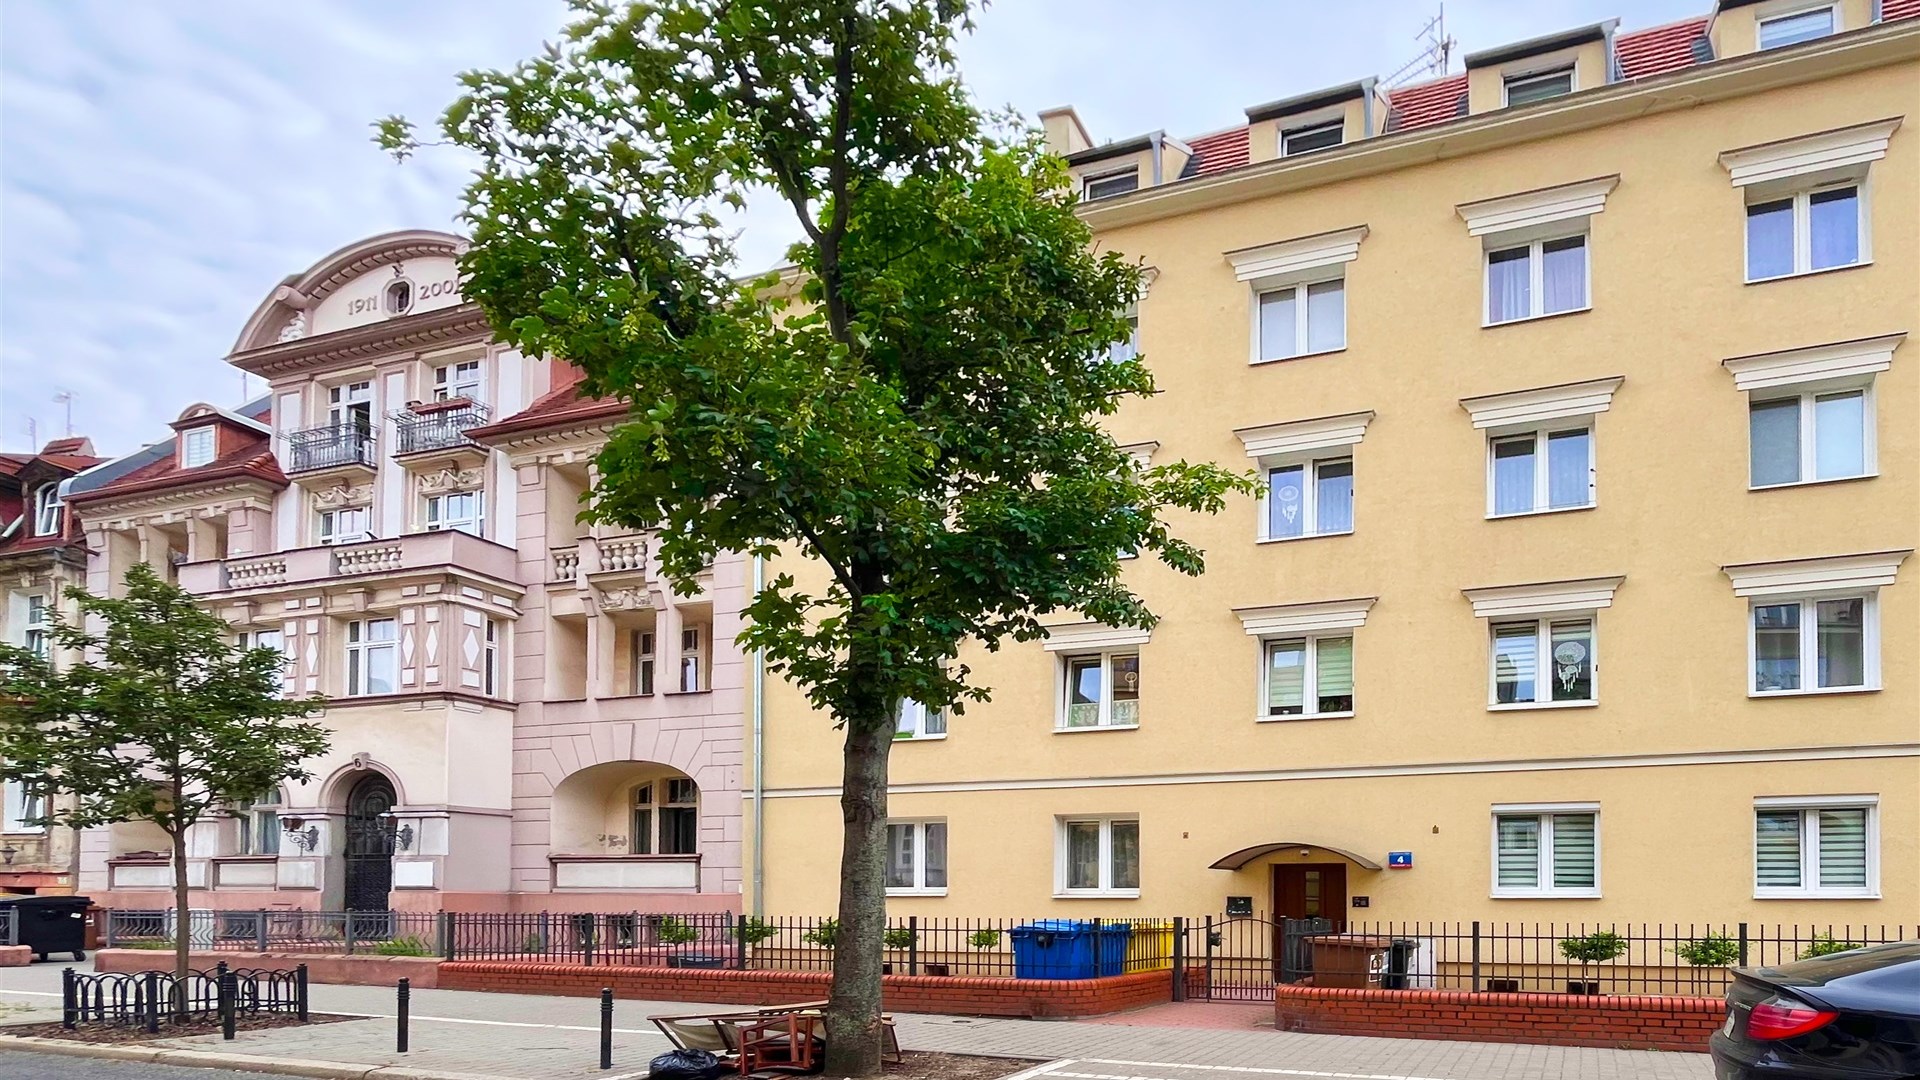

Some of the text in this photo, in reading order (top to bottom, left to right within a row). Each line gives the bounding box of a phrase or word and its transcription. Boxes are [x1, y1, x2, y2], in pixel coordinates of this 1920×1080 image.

[348, 295, 377, 315] 1911
[354, 757, 362, 768] 6
[1397, 855, 1404, 864] 4
